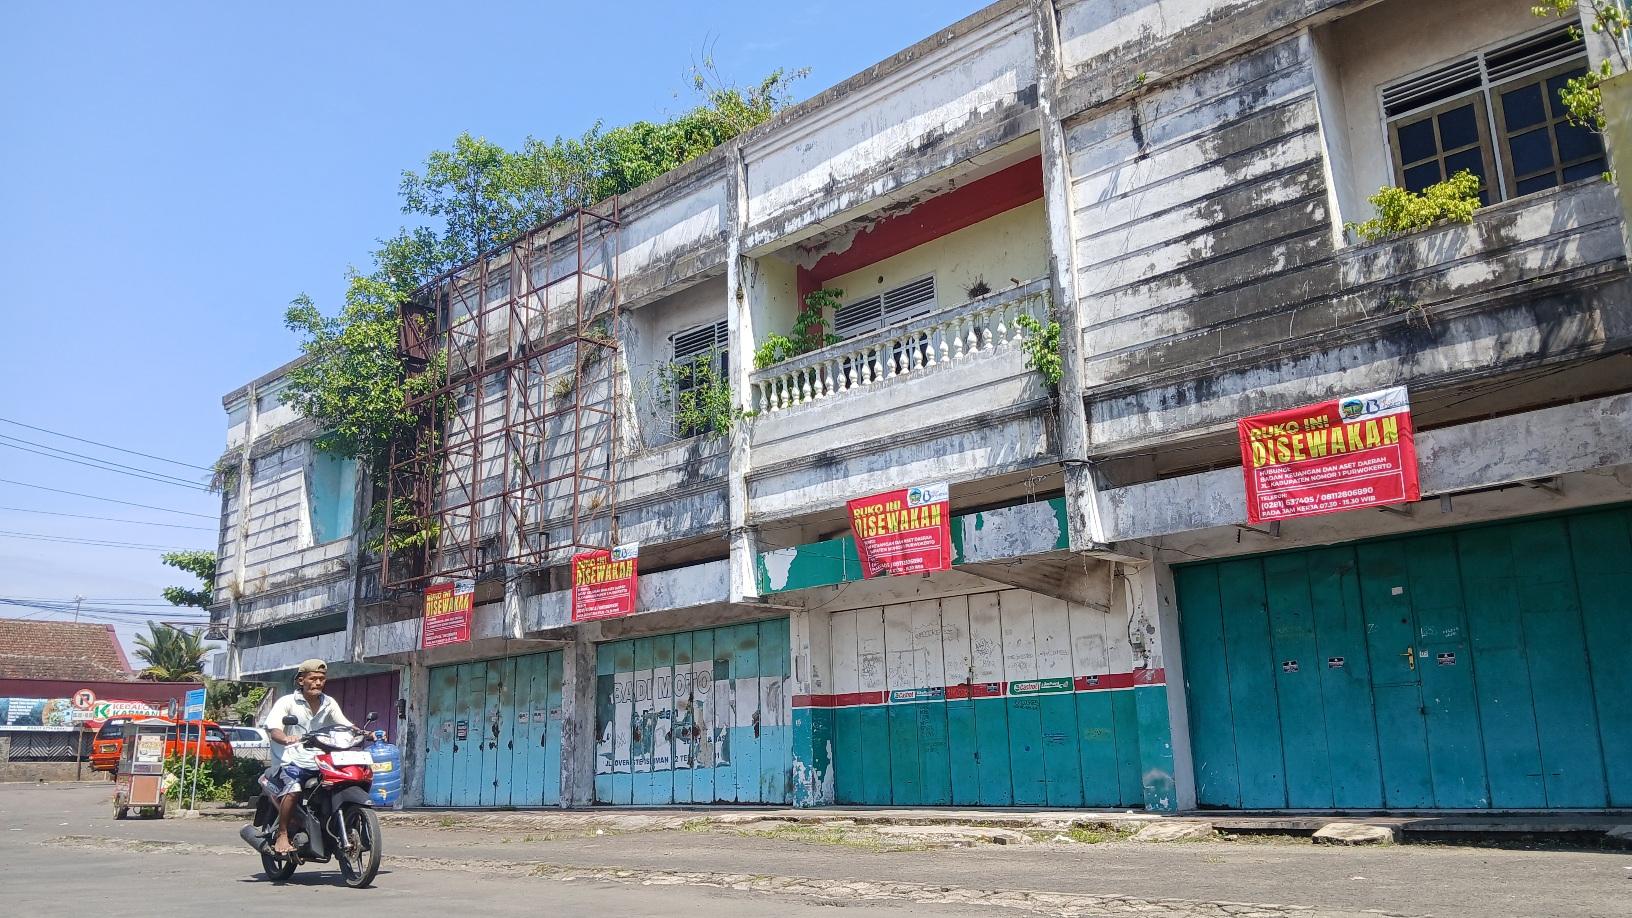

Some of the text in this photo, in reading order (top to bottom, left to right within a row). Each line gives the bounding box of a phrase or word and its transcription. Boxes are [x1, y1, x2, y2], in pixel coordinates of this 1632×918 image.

[1250, 415, 1329, 440] RUKO INI
[1251, 416, 1399, 467] DISEWAKAN
[1260, 457, 1387, 483] BADAN KEUANGAN DAN ASET DAERAH
[1271, 477, 1310, 488] KABUPATEN
[1311, 473, 1337, 482] NOMOR
[1342, 463, 1392, 476] PURWOKERTO
[853, 500, 901, 517] RUKO INI
[1262, 501, 1284, 511] (0281)
[1262, 509, 1281, 517] PADA
[1281, 507, 1295, 515] JAM
[1296, 505, 1319, 513] KERJA
[1360, 495, 1376, 503] WIB
[855, 504, 941, 538] DISEWAKAN
[576, 560, 633, 586] DISEWAKAN
[426, 593, 470, 617] DISEWAKAN
